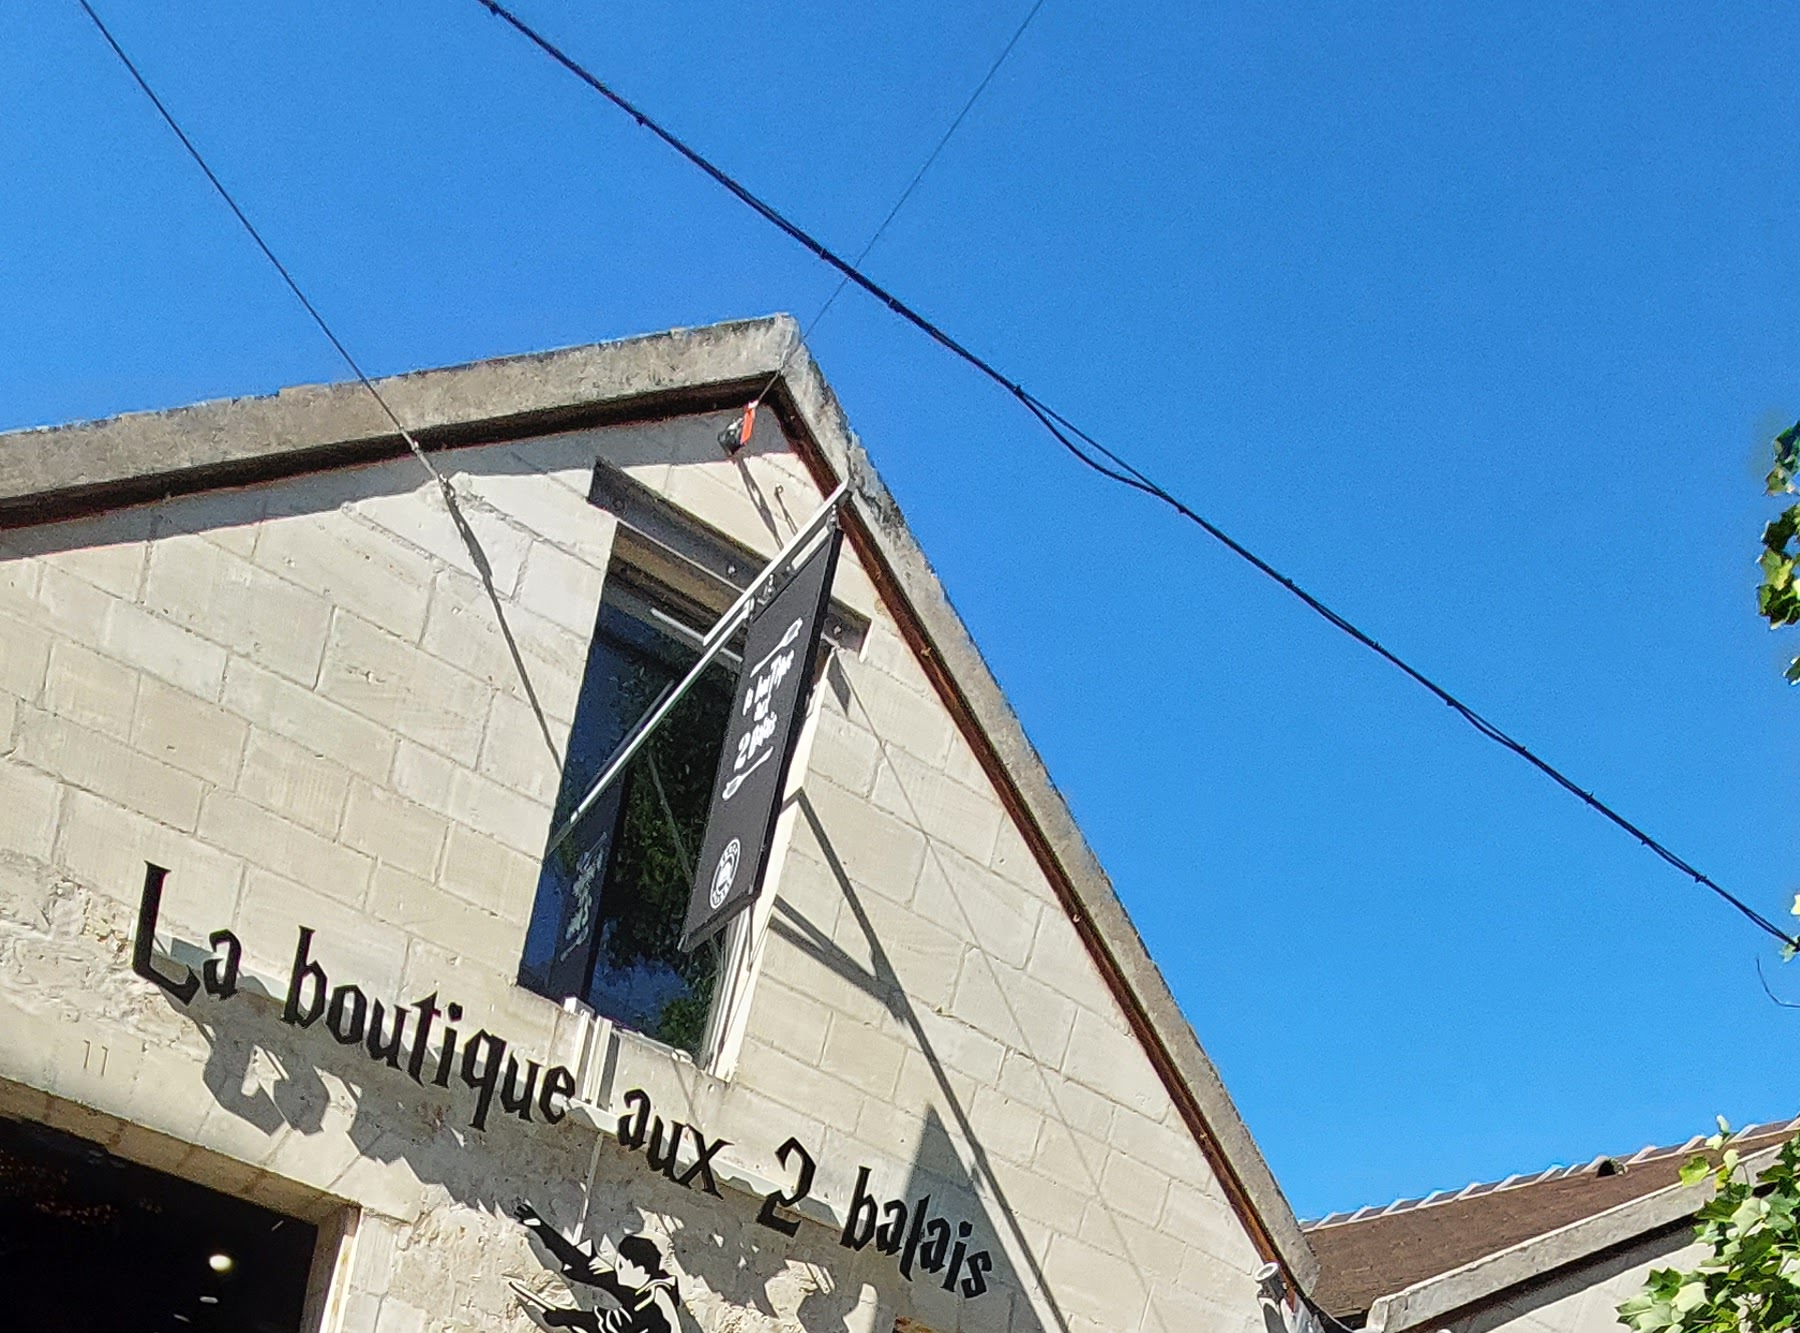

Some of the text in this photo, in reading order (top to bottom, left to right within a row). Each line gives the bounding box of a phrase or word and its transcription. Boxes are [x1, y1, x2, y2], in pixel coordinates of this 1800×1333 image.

[132, 861, 993, 1299] La boutique aux 2 balais
